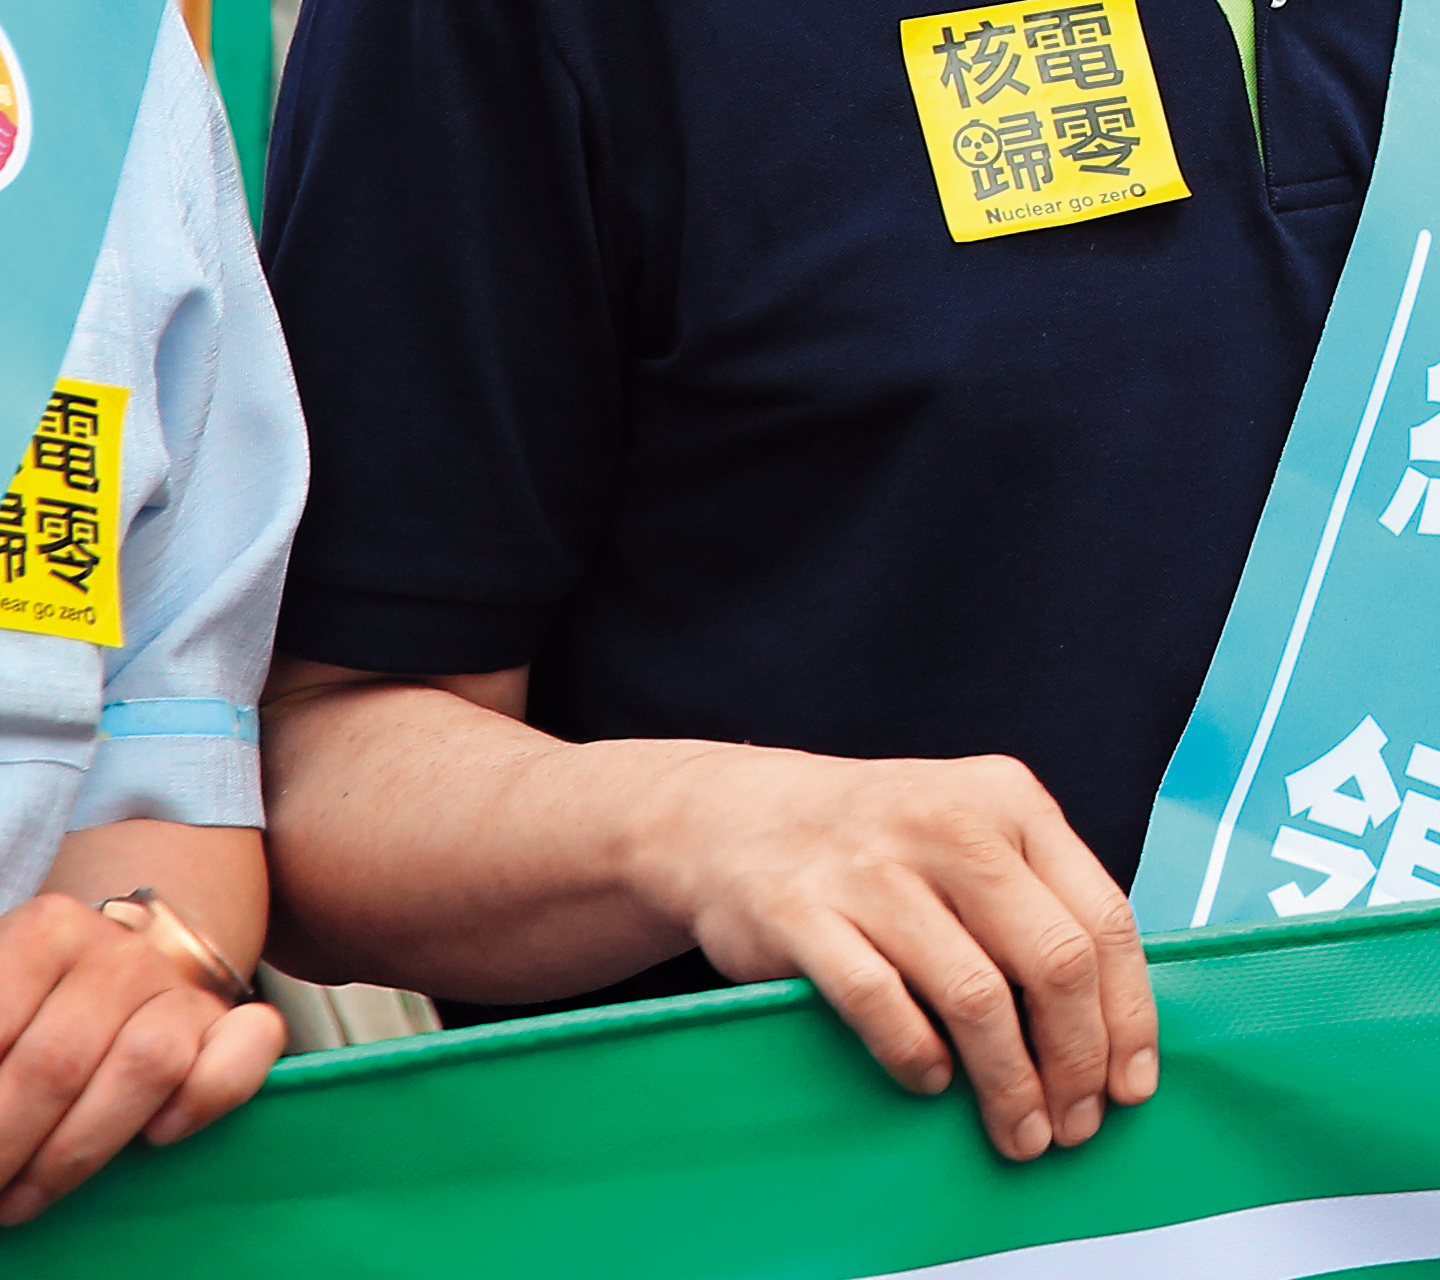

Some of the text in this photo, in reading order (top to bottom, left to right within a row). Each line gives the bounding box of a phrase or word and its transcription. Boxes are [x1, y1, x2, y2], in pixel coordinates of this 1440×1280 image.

[932, 1, 1125, 109] 核電
[952, 95, 1142, 202] 歸零
[985, 200, 1063, 225] Nuclear
[1068, 195, 1094, 213] go
[22, 390, 99, 495] 電
[33, 602, 55, 621] go
